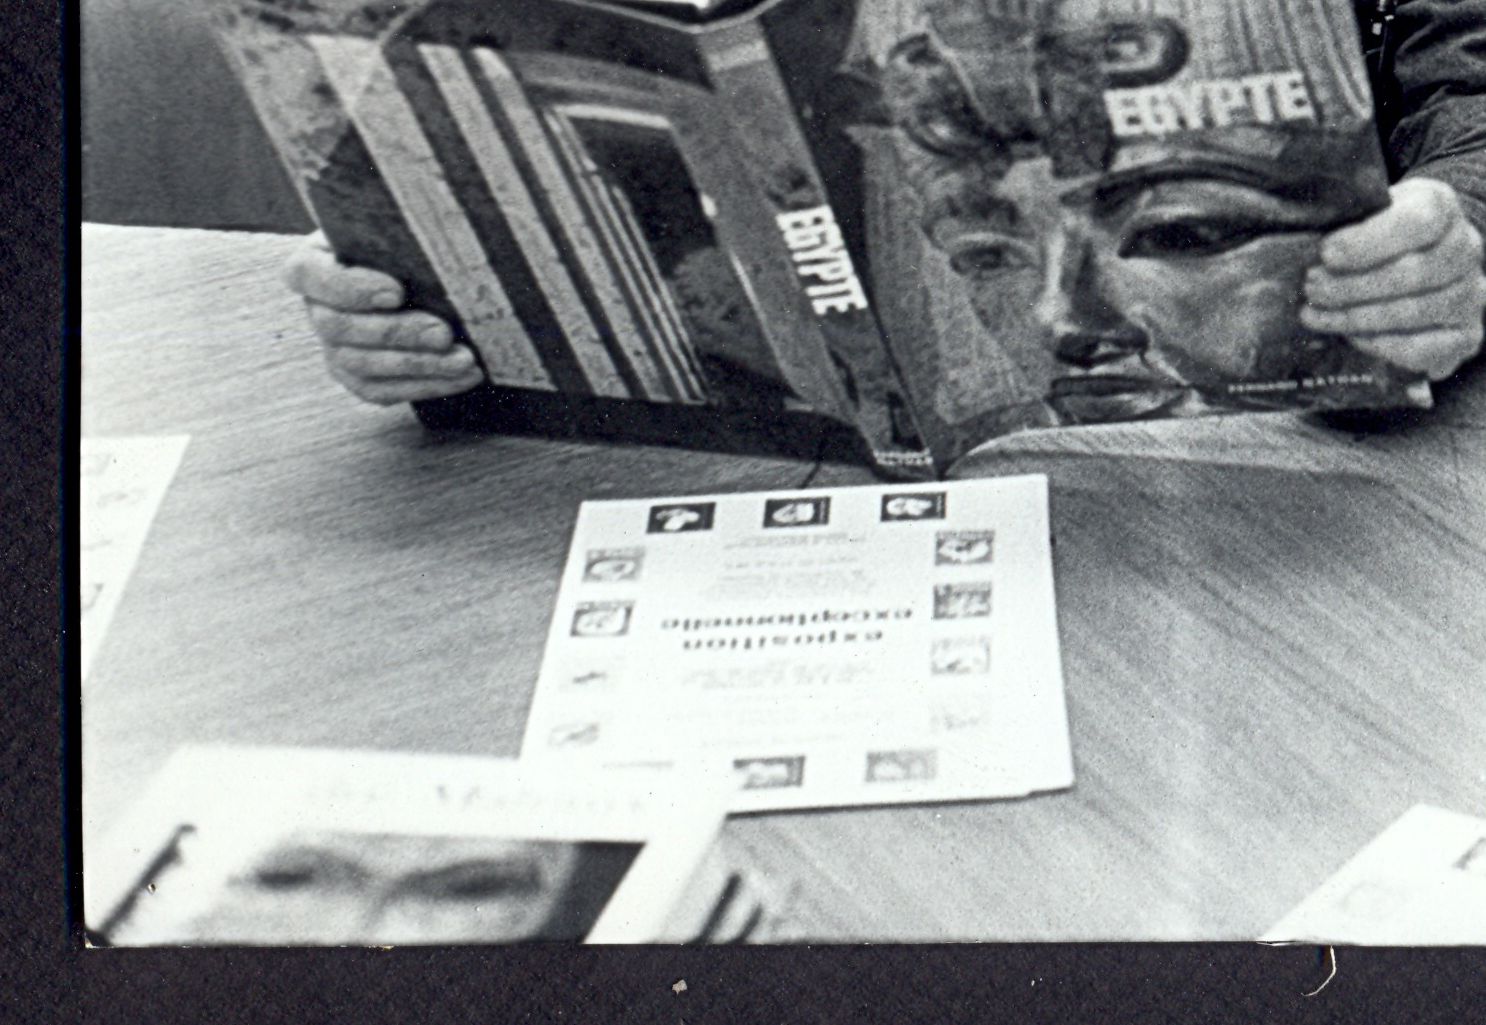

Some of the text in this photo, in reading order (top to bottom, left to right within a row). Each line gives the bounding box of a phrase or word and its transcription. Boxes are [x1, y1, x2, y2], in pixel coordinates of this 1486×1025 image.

[1104, 70, 1314, 137] EGYPTE
[774, 203, 869, 316] EGYPTE
[682, 630, 884, 650] exposition
